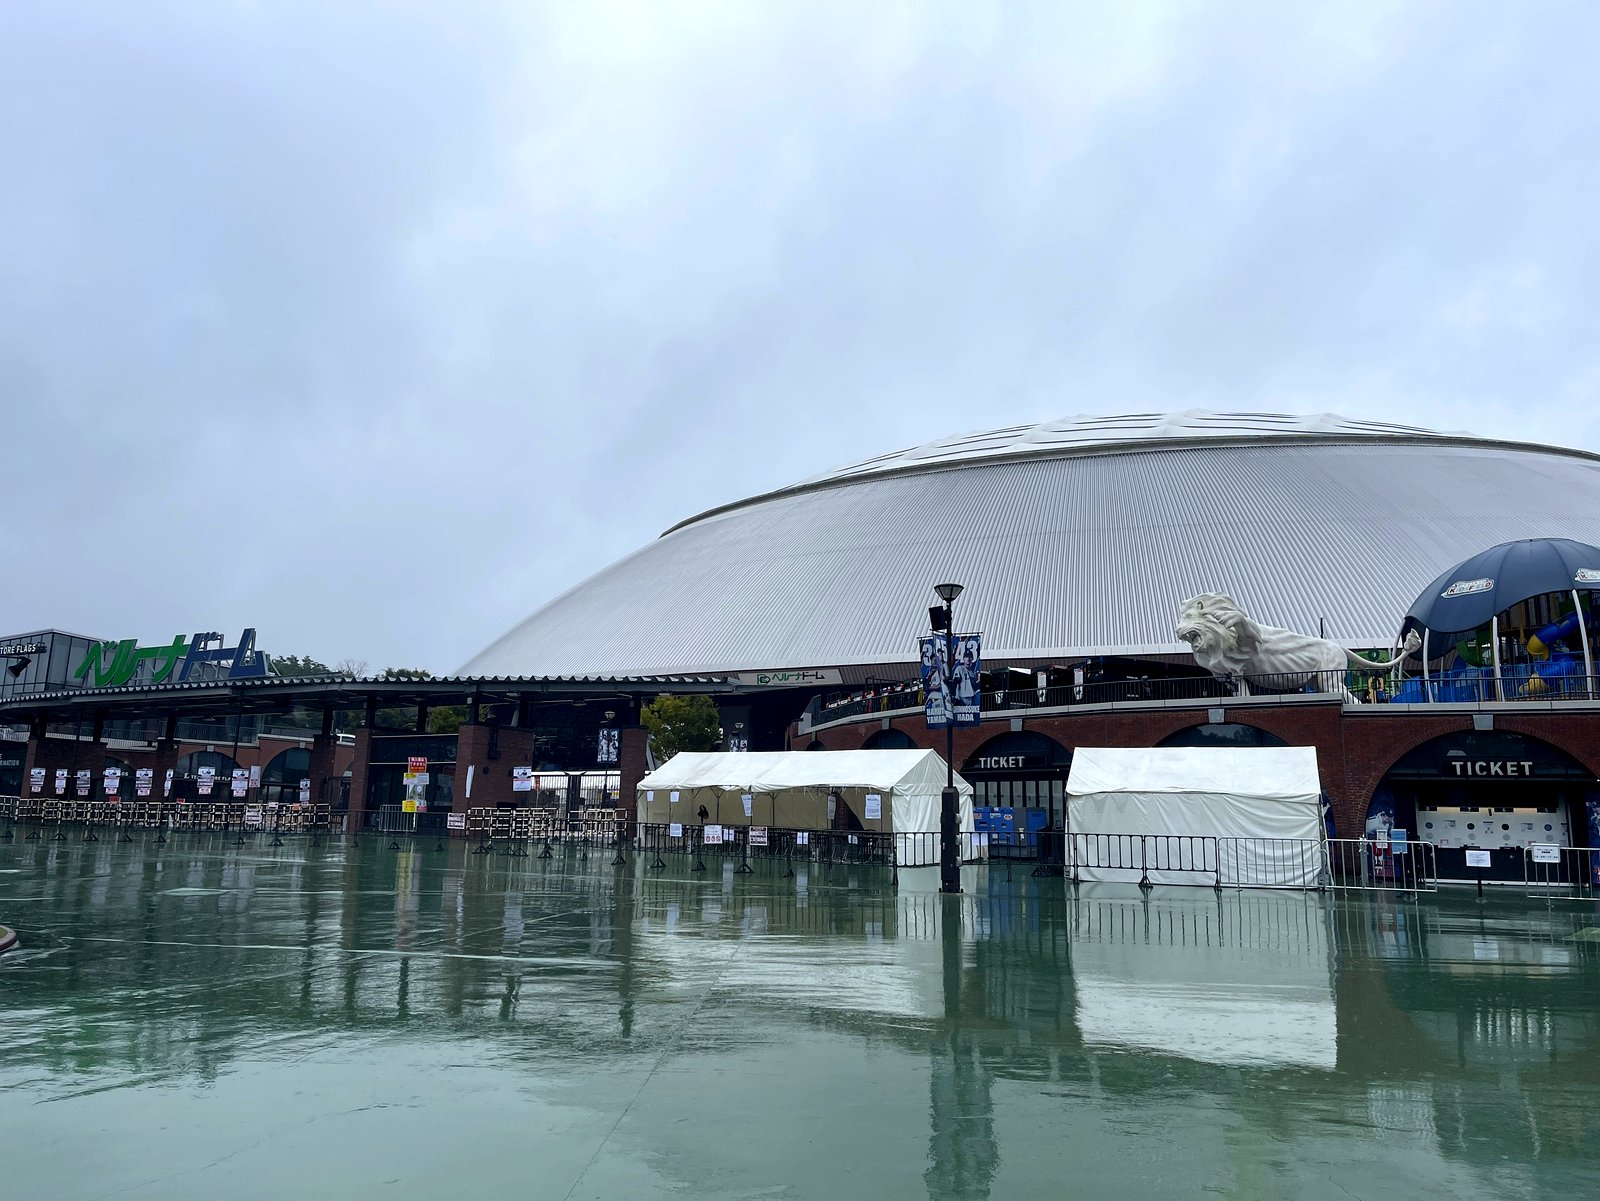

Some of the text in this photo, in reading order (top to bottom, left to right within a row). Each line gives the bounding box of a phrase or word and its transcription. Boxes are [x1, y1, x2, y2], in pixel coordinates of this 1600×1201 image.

[16, 644, 36, 653] FLAGS
[955, 640, 978, 663] 43
[74, 628, 268, 686] ベルーナドーム
[772, 671, 825, 682] ベルーナドーム
[927, 715, 947, 724] YAMAD
[957, 713, 975, 722] HADA
[979, 756, 1025, 769] TICKET
[1452, 761, 1533, 776] TICKET
